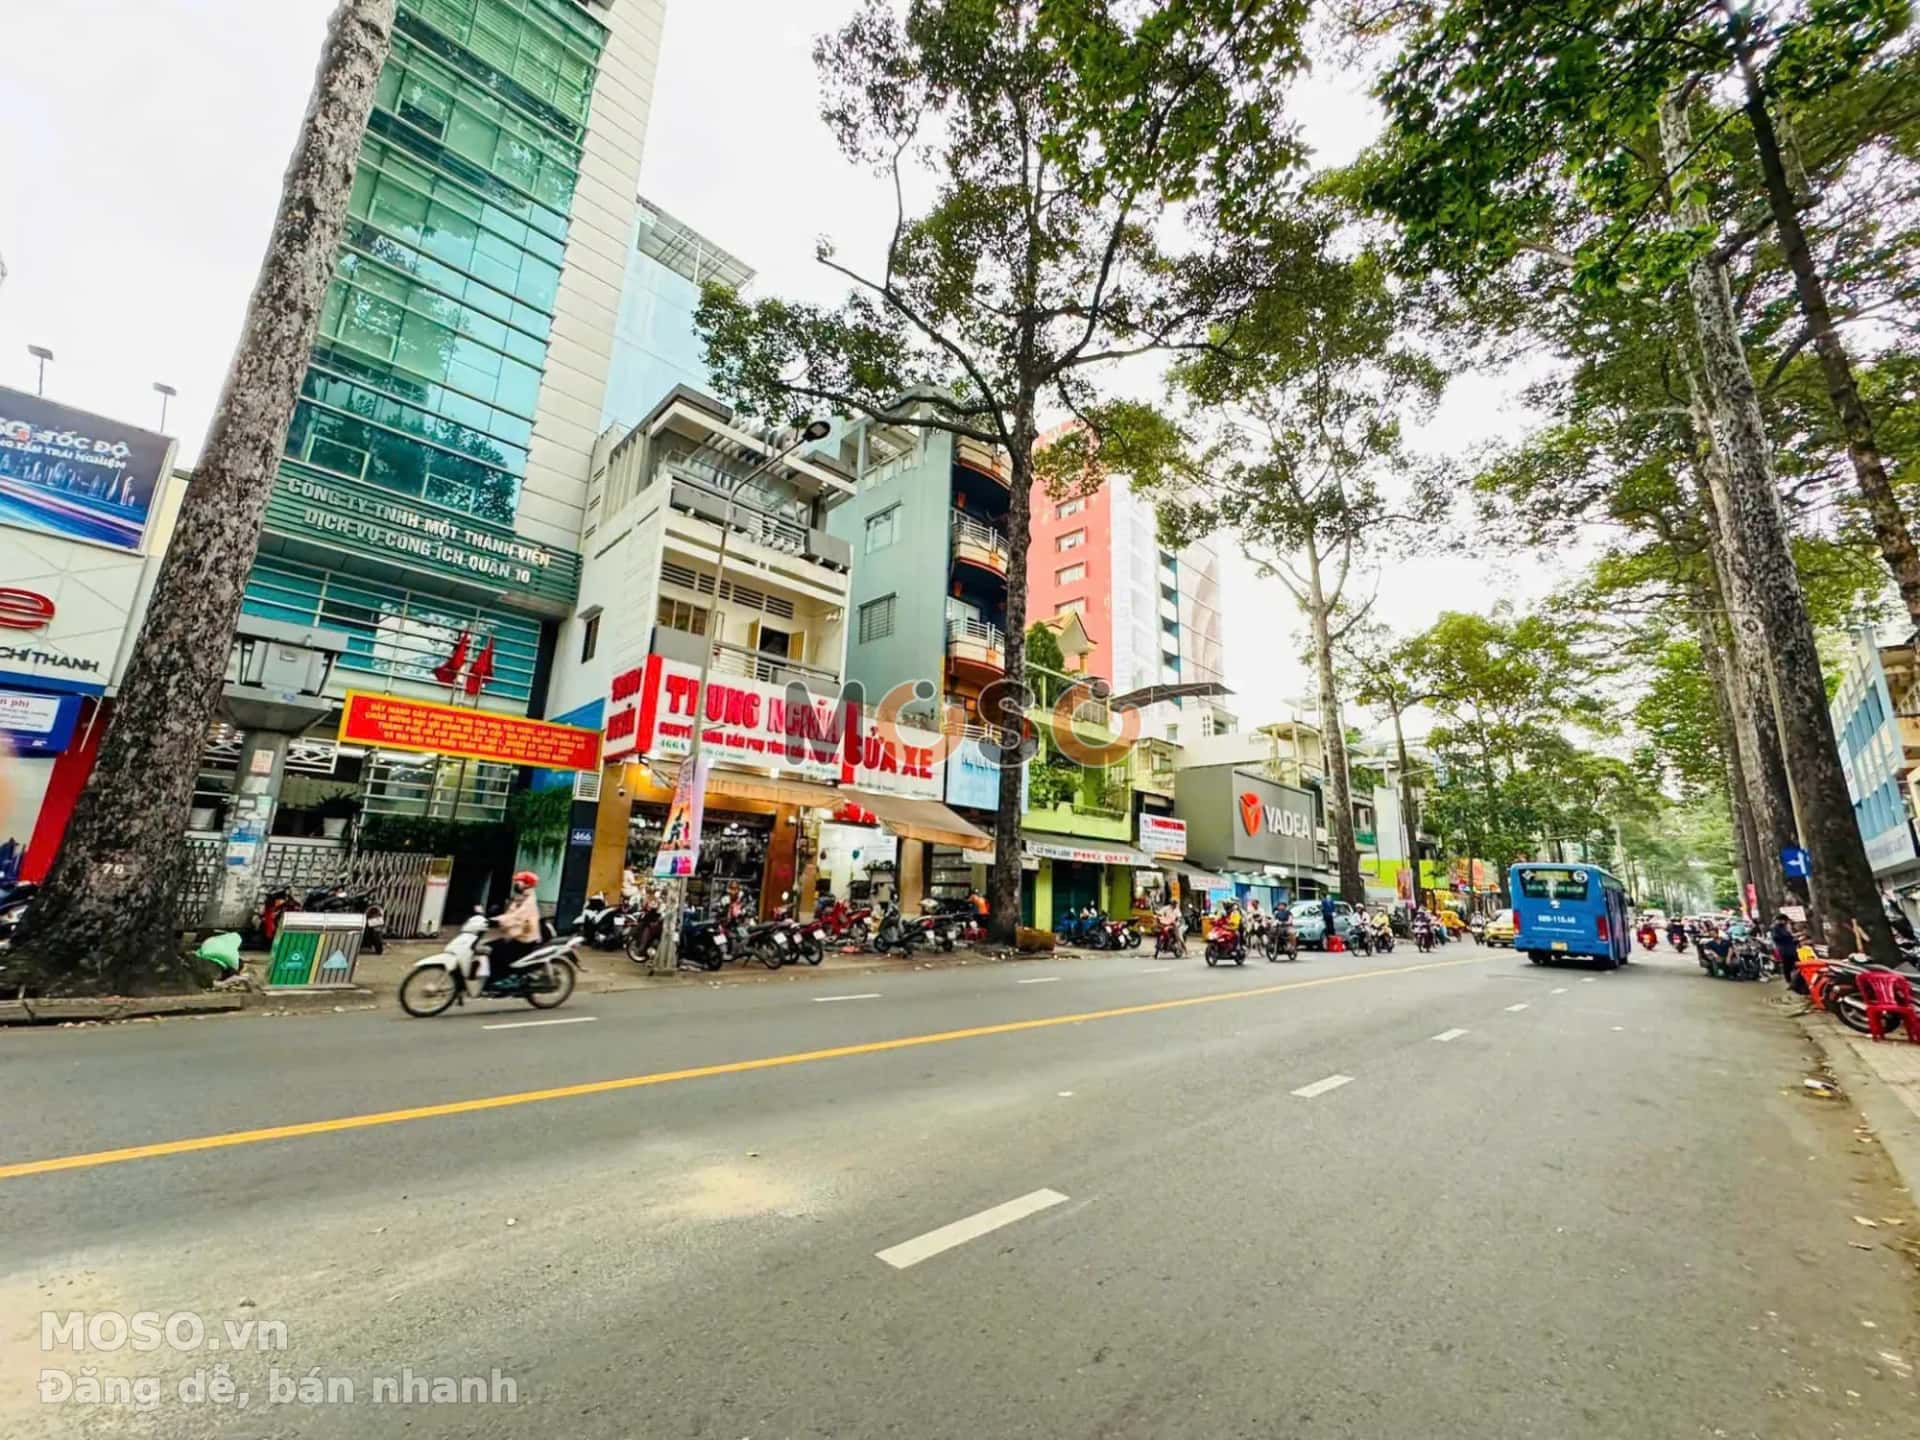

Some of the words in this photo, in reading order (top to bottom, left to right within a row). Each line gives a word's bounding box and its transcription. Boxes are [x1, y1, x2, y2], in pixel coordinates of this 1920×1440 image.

[286, 477, 339, 506] CÔNG
[345, 493, 369, 513] TY
[374, 503, 420, 528] TNHH
[424, 518, 460, 540] MỘT
[303, 508, 350, 533] DỊCH
[356, 522, 379, 544] VỤ
[385, 531, 431, 557] CÔNG
[435, 541, 464, 564] ÍCH
[468, 555, 511, 577] QUẬN
[515, 568, 531, 584] 10
[31, 651, 99, 672] THANH
[901, 744, 933, 780] XE
[573, 831, 592, 841] 466
[1263, 804, 1313, 840] YADEA
